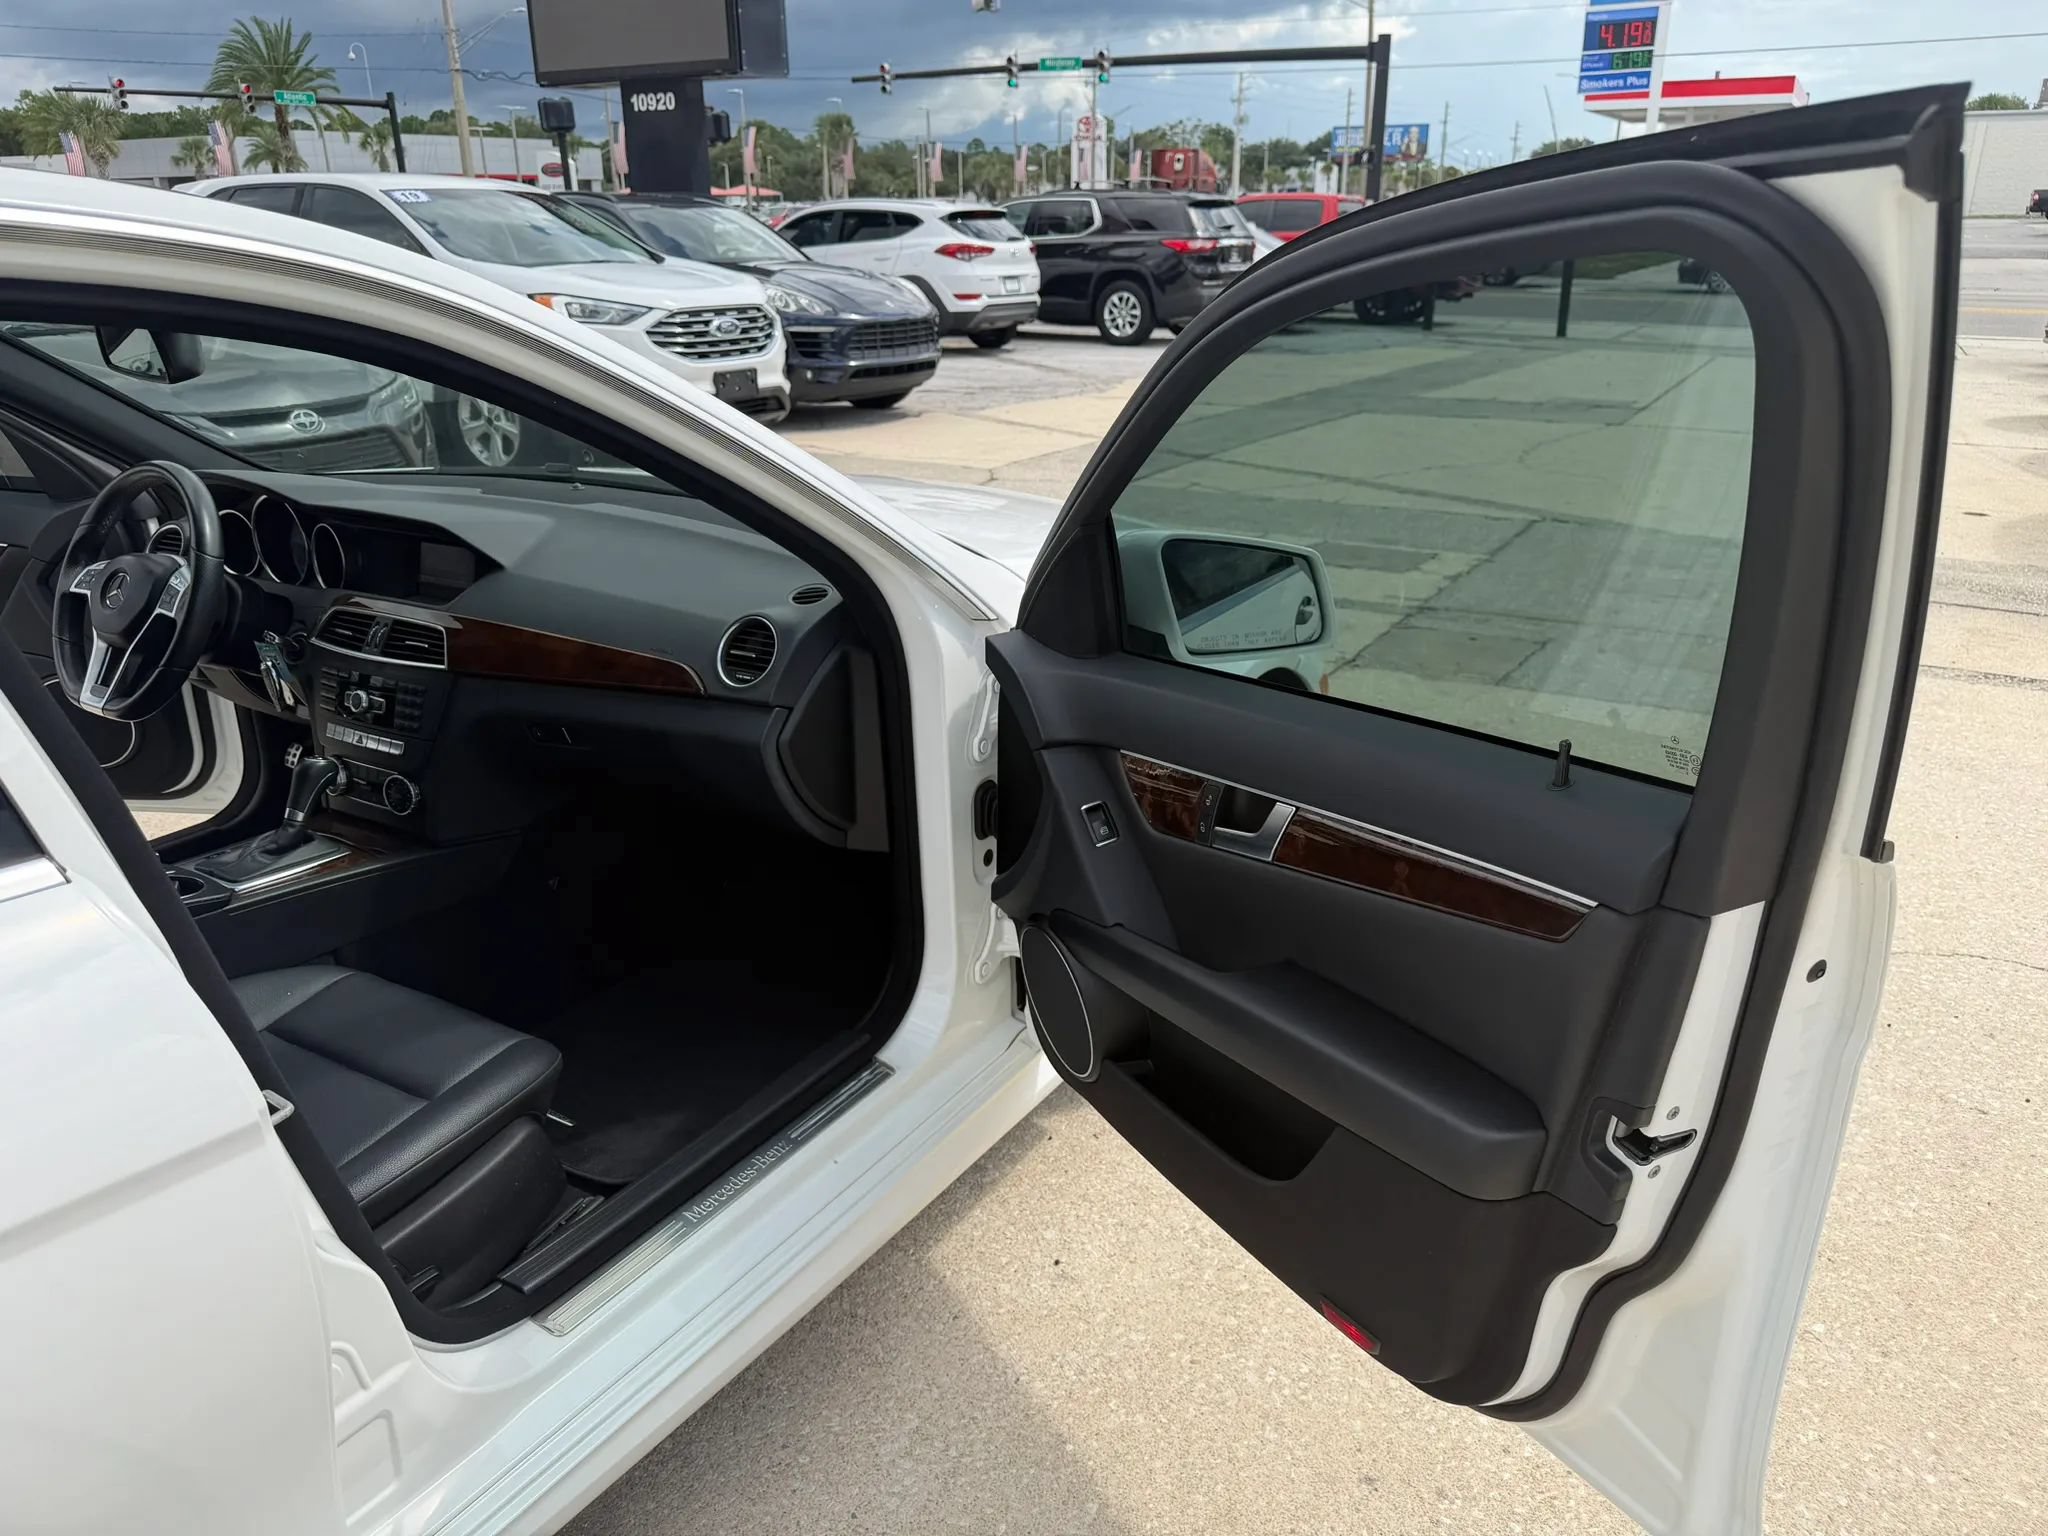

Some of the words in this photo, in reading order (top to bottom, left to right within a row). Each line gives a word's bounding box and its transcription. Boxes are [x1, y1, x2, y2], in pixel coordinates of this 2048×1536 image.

[1581, 78, 1624, 90] Smokers
[1626, 76, 1648, 87] Plus
[630, 92, 676, 112] 10920
[682, 1140, 793, 1222] Mercedes-Benz
